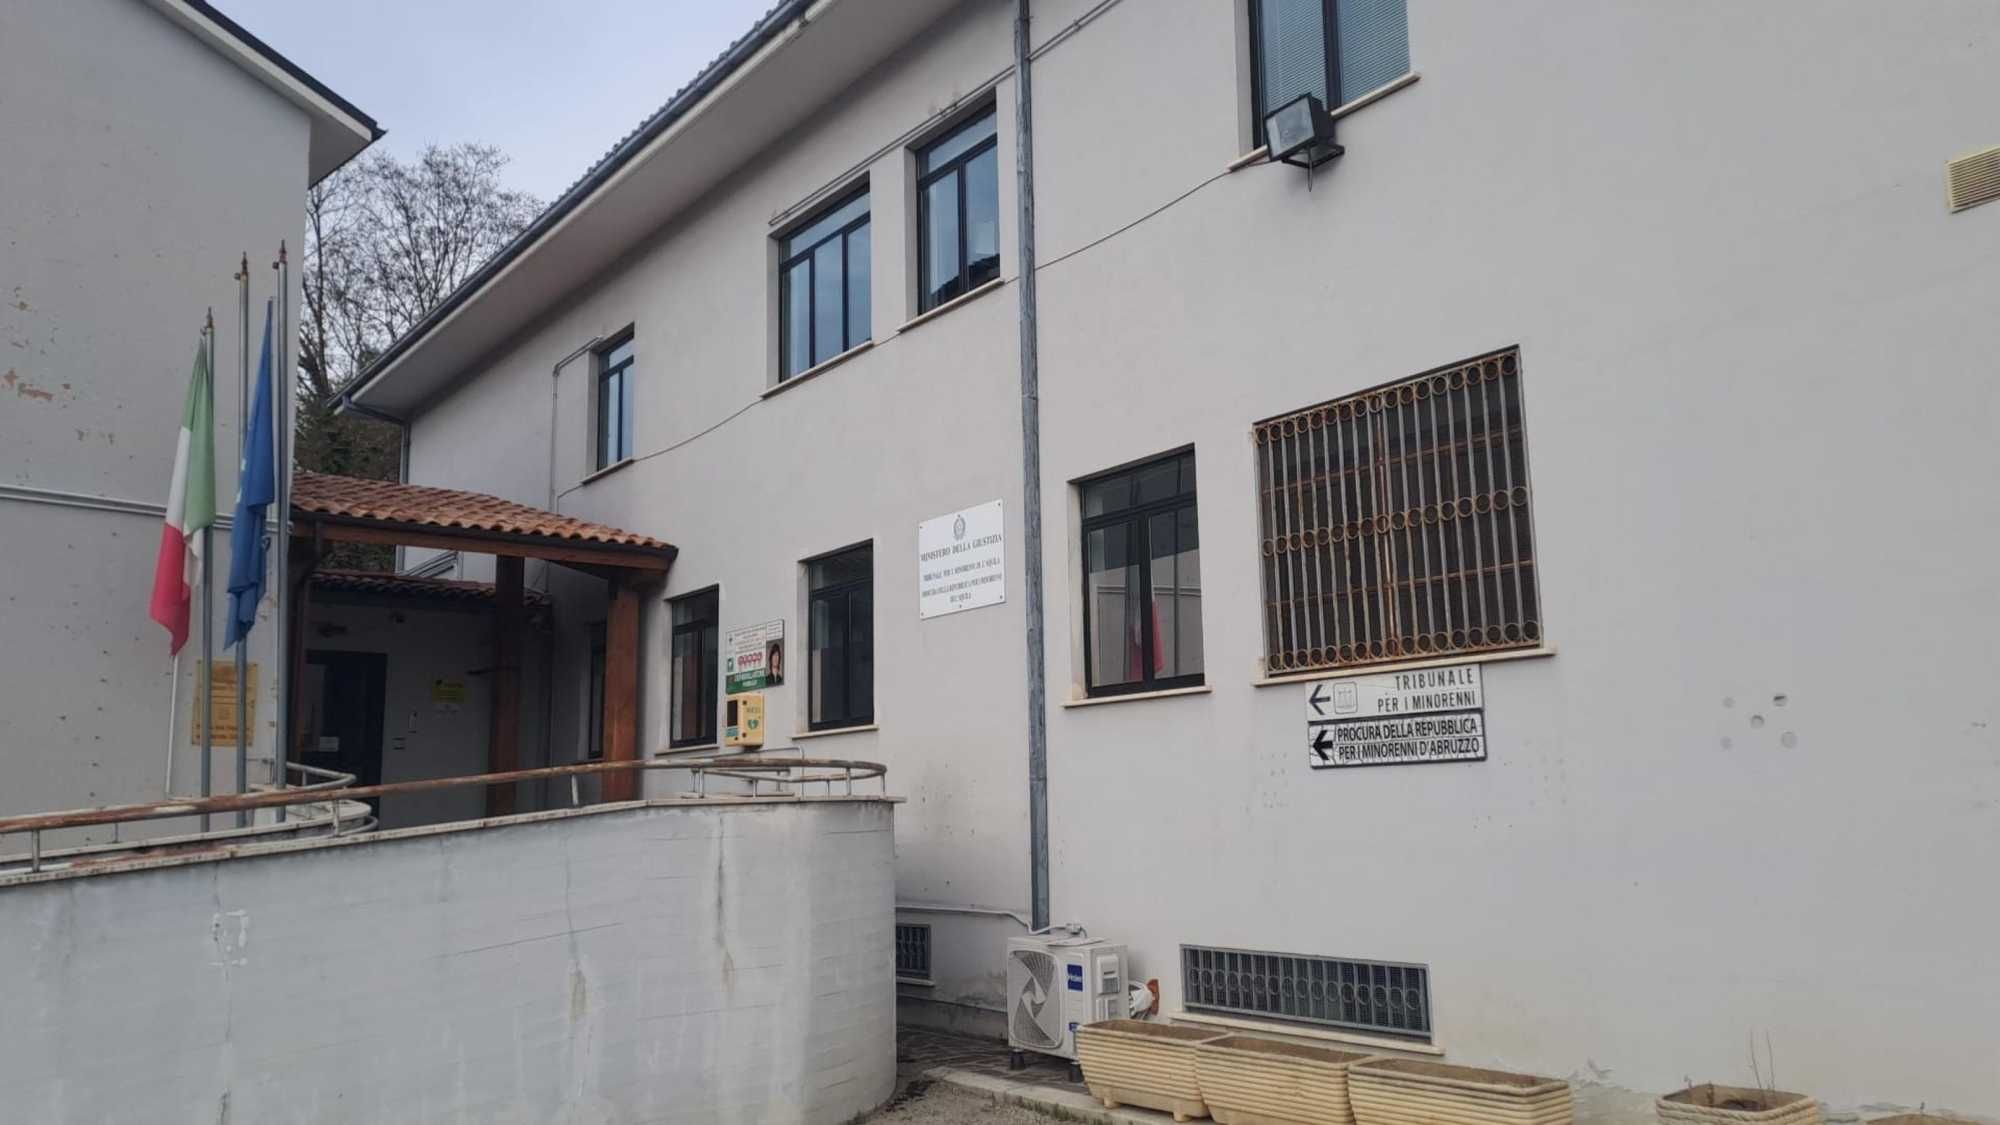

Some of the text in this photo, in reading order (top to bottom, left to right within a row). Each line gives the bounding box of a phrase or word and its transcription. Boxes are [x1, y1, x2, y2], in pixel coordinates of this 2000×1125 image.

[952, 543, 970, 555] DELLA
[1395, 668, 1474, 691] TRIBUNALE
[1377, 690, 1476, 713] PER I MINORENNI
[1337, 718, 1478, 742] PROCURA DELLA REPUBBLICA
[1339, 745, 1357, 760] PER
[1362, 741, 1418, 759] MINORENNI
[1419, 737, 1480, 756] D'ABRUZZO
